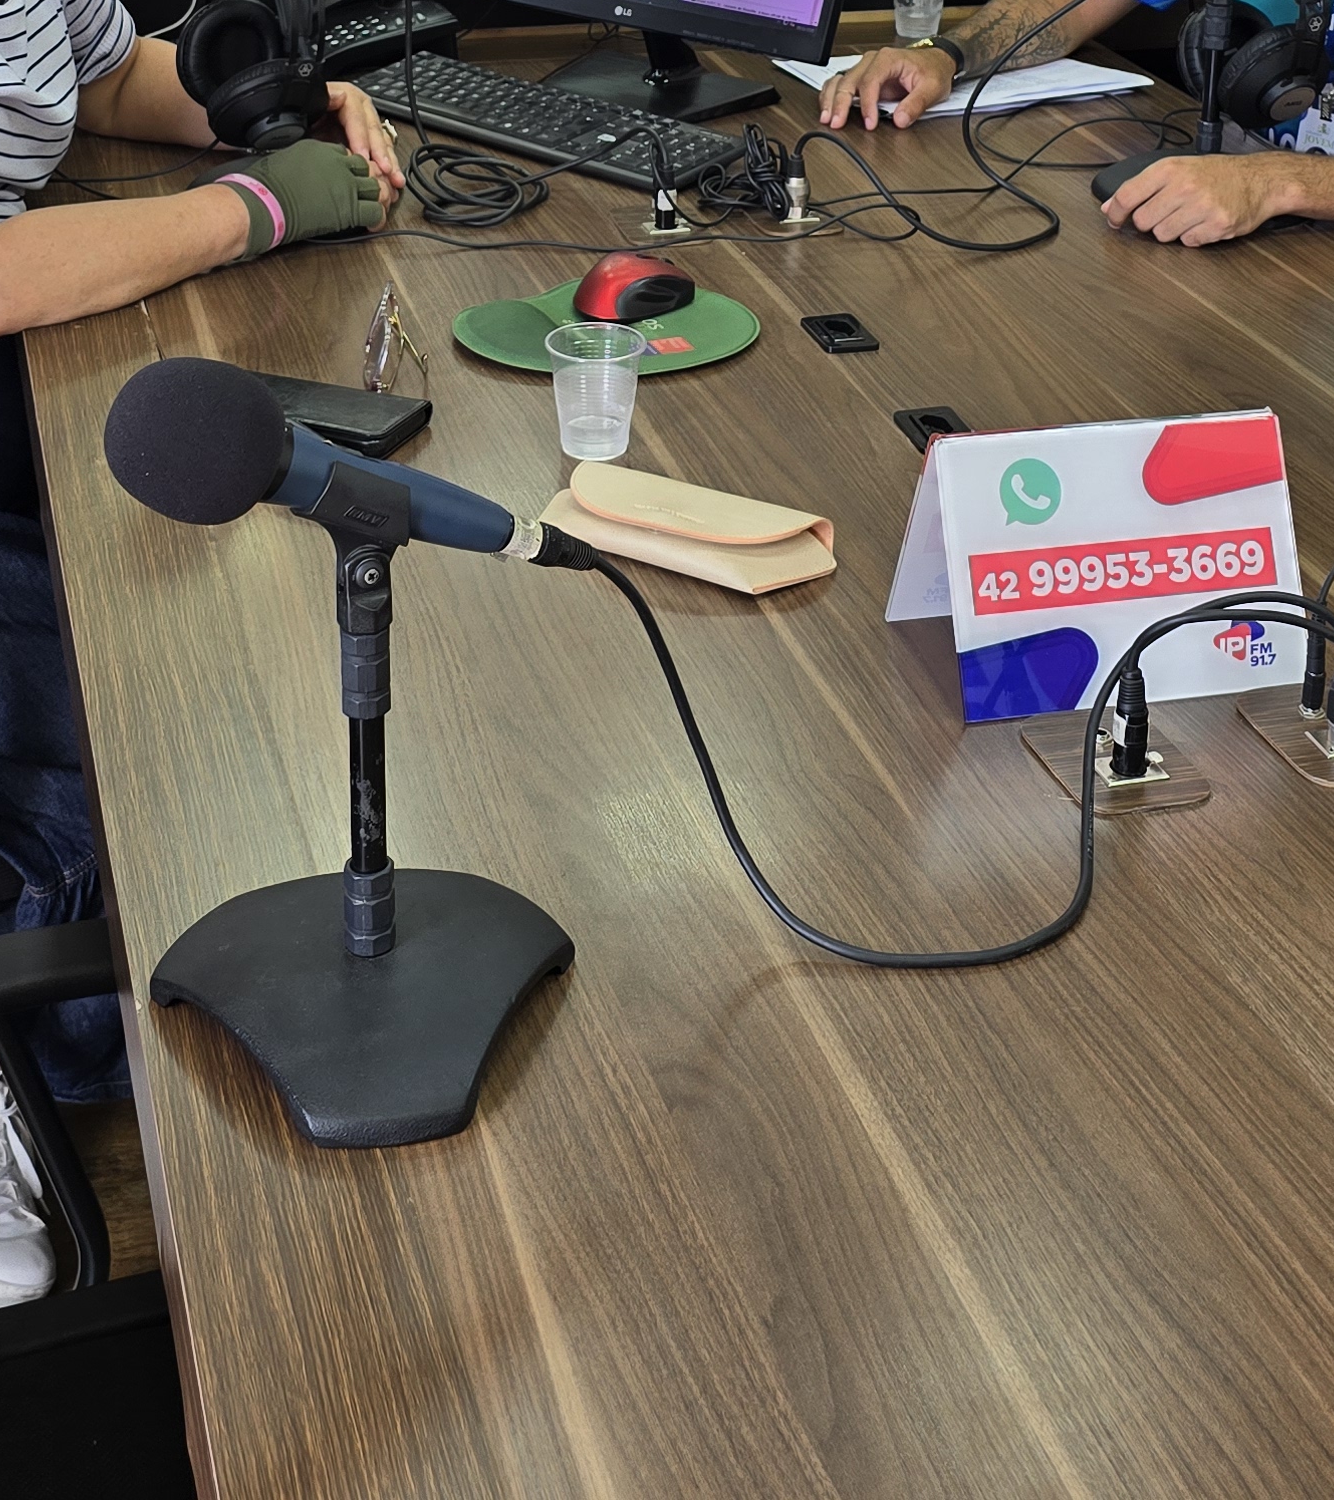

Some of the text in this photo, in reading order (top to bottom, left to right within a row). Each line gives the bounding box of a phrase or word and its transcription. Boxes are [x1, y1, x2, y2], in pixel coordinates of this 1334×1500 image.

[623, 8, 632, 16] LG
[978, 540, 1265, 601] 42 99953-3669
[1250, 643, 1272, 655] FM
[1250, 653, 1277, 667] 91.7
